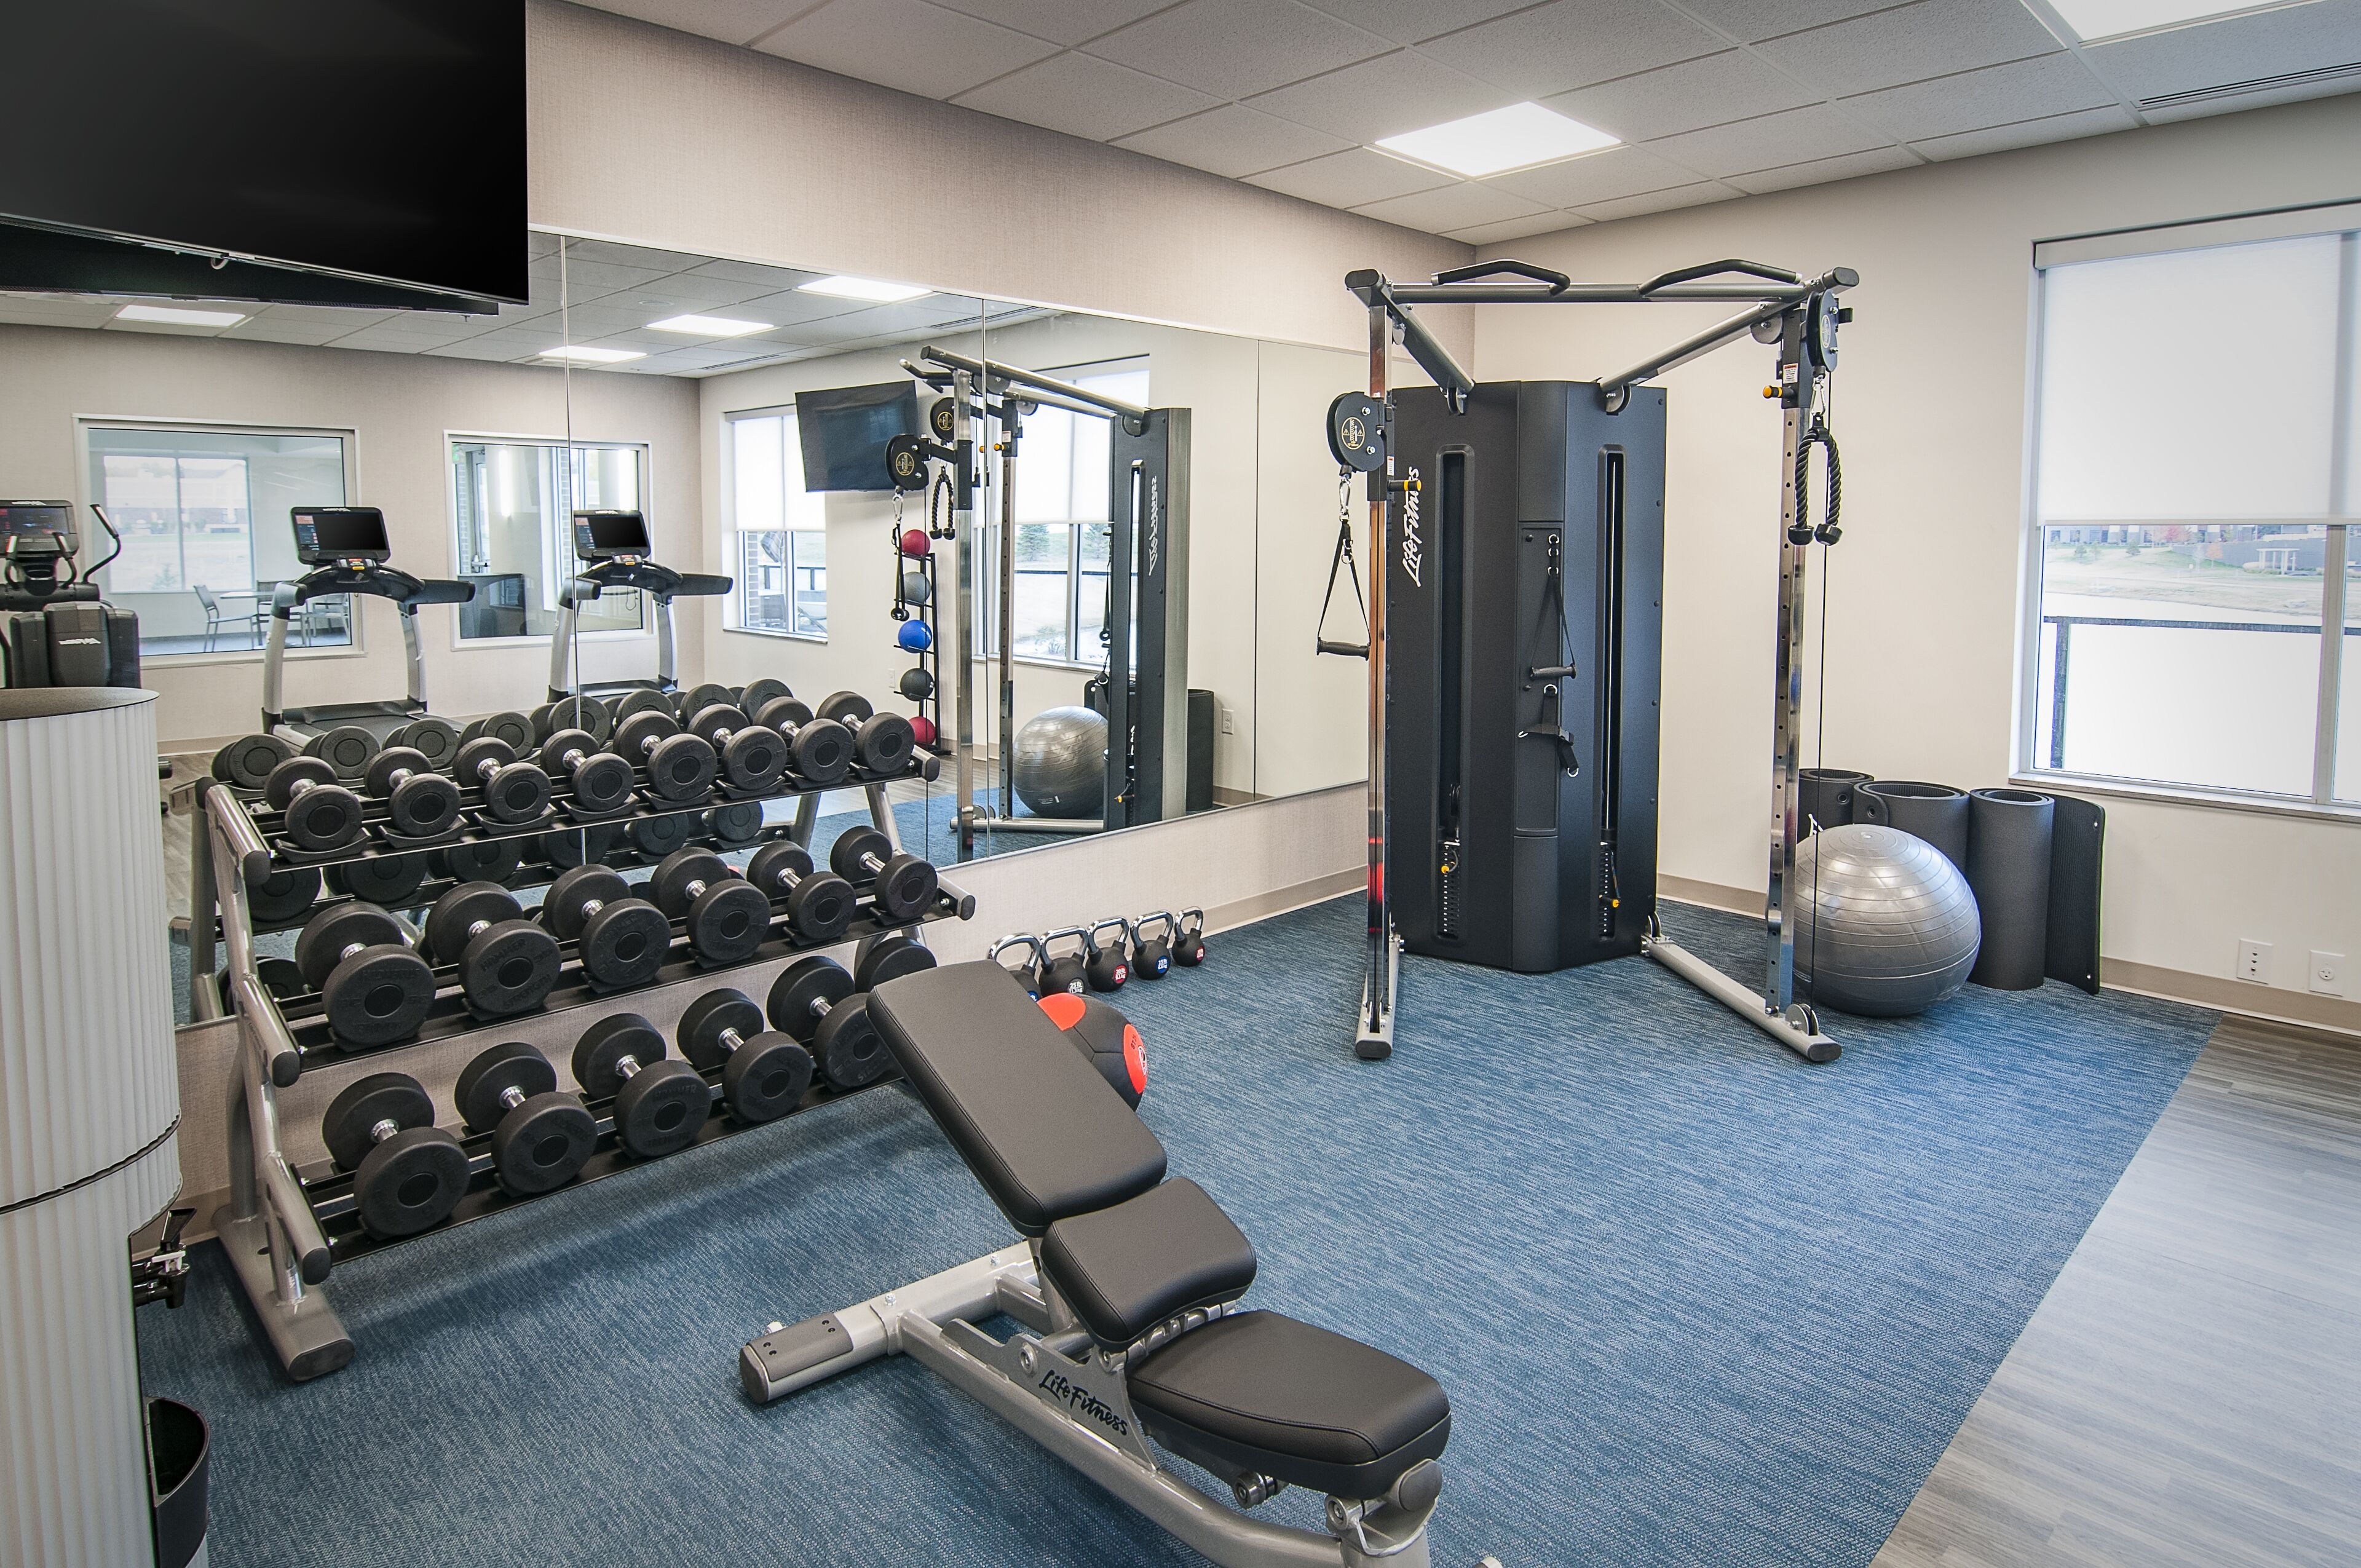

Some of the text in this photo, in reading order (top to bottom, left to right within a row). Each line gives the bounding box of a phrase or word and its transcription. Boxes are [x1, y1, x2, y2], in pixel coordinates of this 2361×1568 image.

[1402, 539, 1422, 587] Life
[1038, 1369, 1128, 1436] Life Fitness
